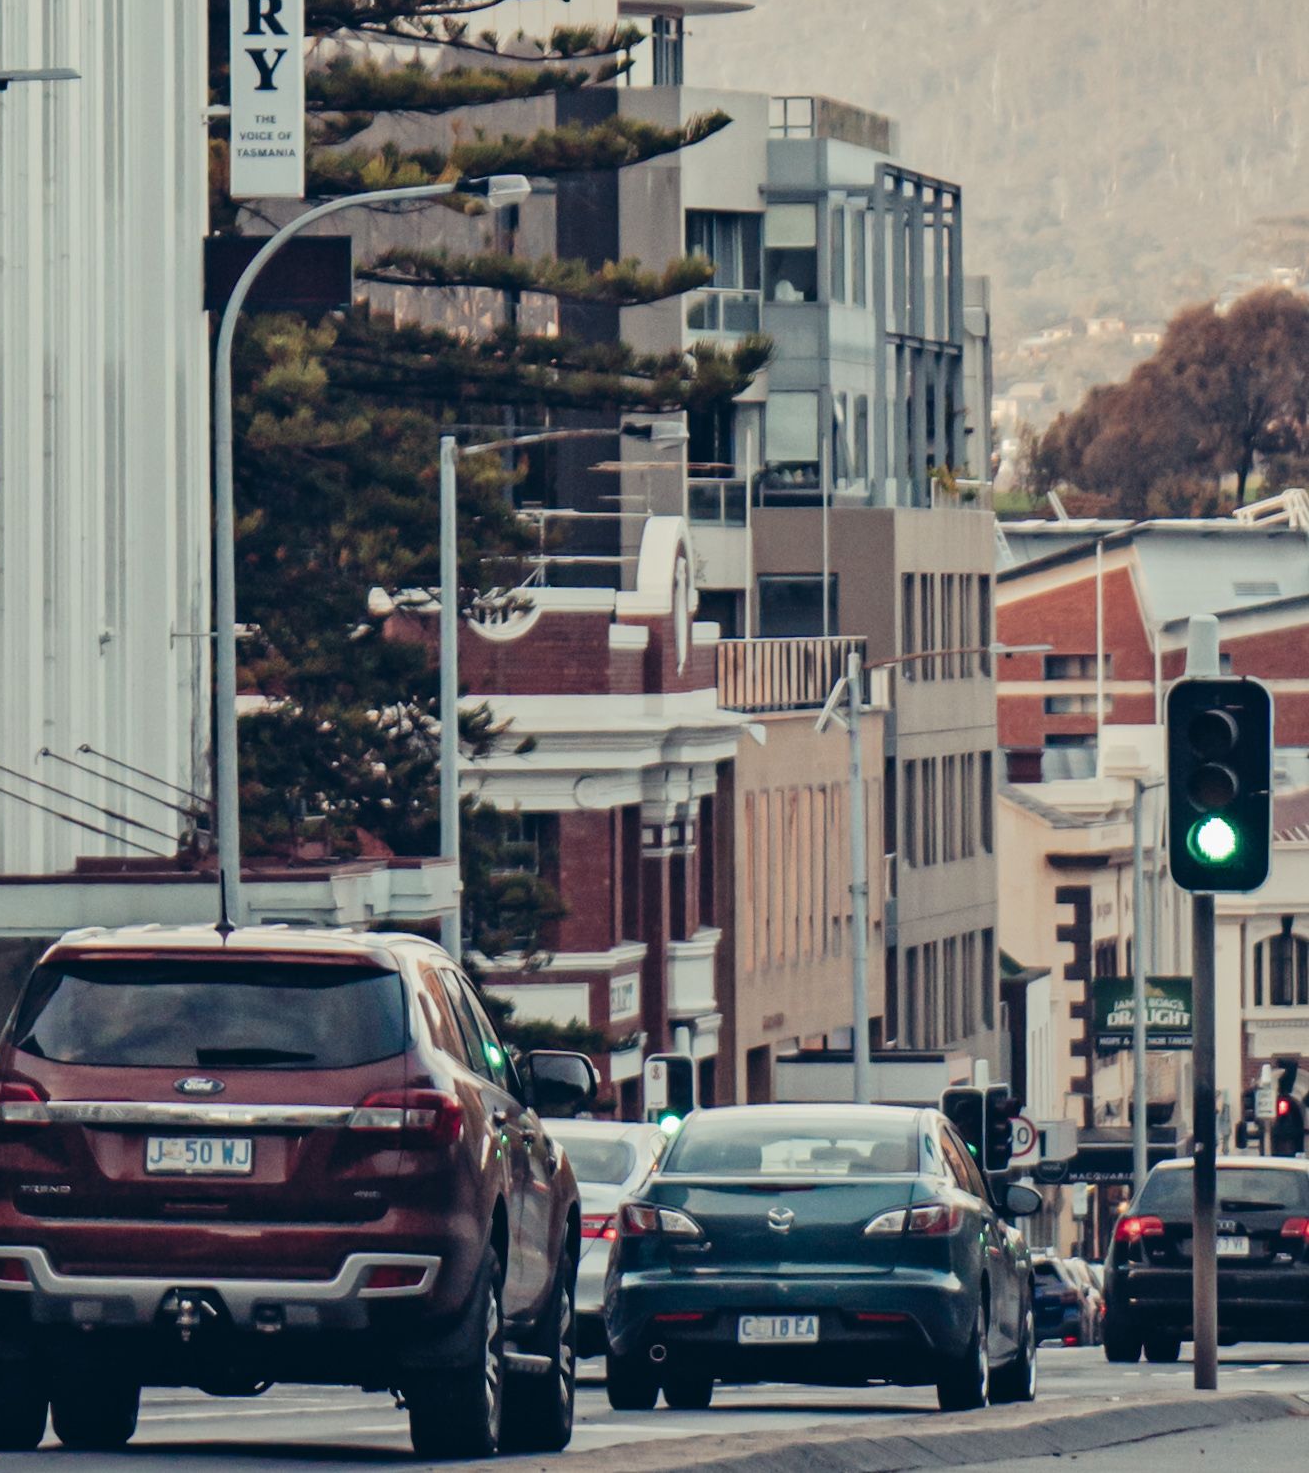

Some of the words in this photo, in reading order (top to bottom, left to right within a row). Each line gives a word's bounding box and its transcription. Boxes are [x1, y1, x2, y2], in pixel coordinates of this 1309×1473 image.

[255, 115, 277, 124] THE
[240, 131, 274, 140] VOICE
[277, 131, 293, 140] OF
[237, 148, 296, 157] TASMANIA
[1107, 1009, 1191, 1026] DRUGHT
[21, 1185, 71, 1194] TREND
